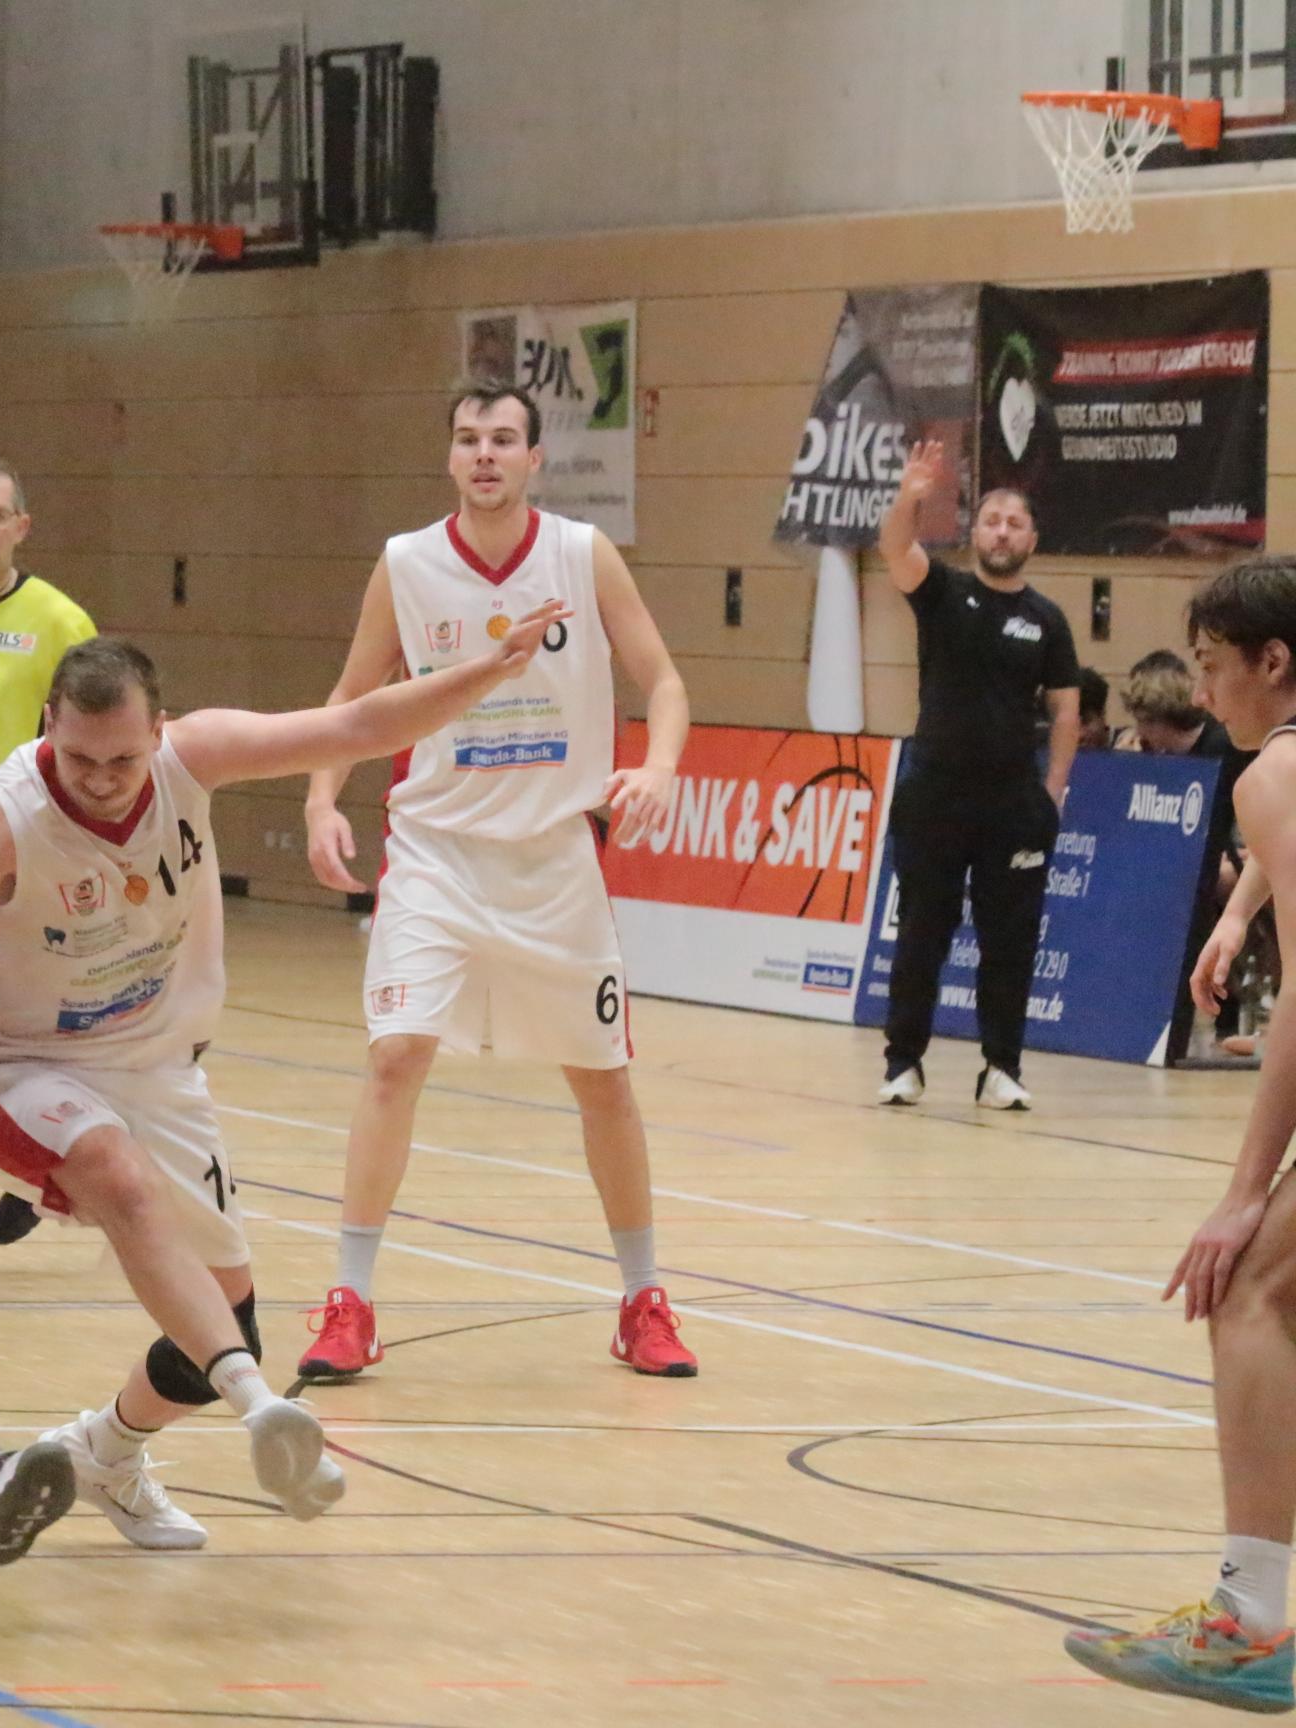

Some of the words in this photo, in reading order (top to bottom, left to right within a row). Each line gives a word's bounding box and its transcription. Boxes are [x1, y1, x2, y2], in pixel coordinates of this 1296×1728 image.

[733, 779, 760, 864] &
[764, 781, 873, 873] SAVE
[1128, 783, 1182, 825] Allianz
[156, 818, 203, 897] 14
[595, 975, 620, 1025] 6
